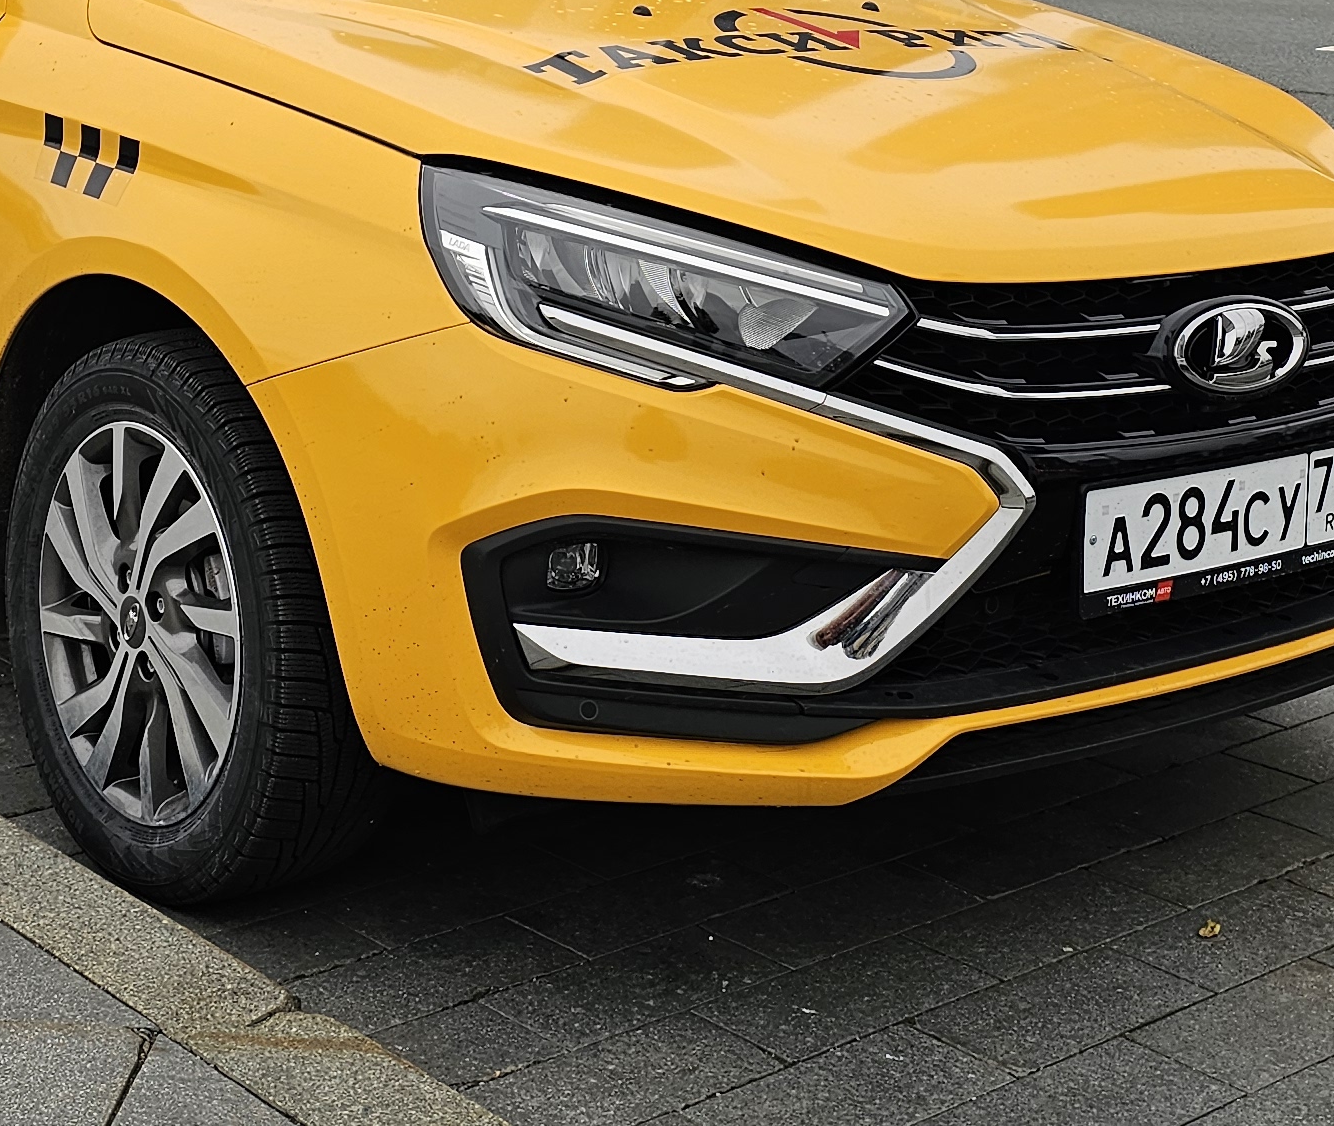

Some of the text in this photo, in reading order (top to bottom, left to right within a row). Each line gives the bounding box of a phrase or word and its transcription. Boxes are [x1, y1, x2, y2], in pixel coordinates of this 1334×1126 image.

[522, 30, 845, 85] ТАКСИ
[448, 237, 471, 252] LADA
[1102, 478, 1302, 578] А284СУ
[1200, 575, 1211, 587] +7
[1213, 570, 1238, 585] (495)
[1107, 587, 1156, 607] ТЕХИНКОМ
